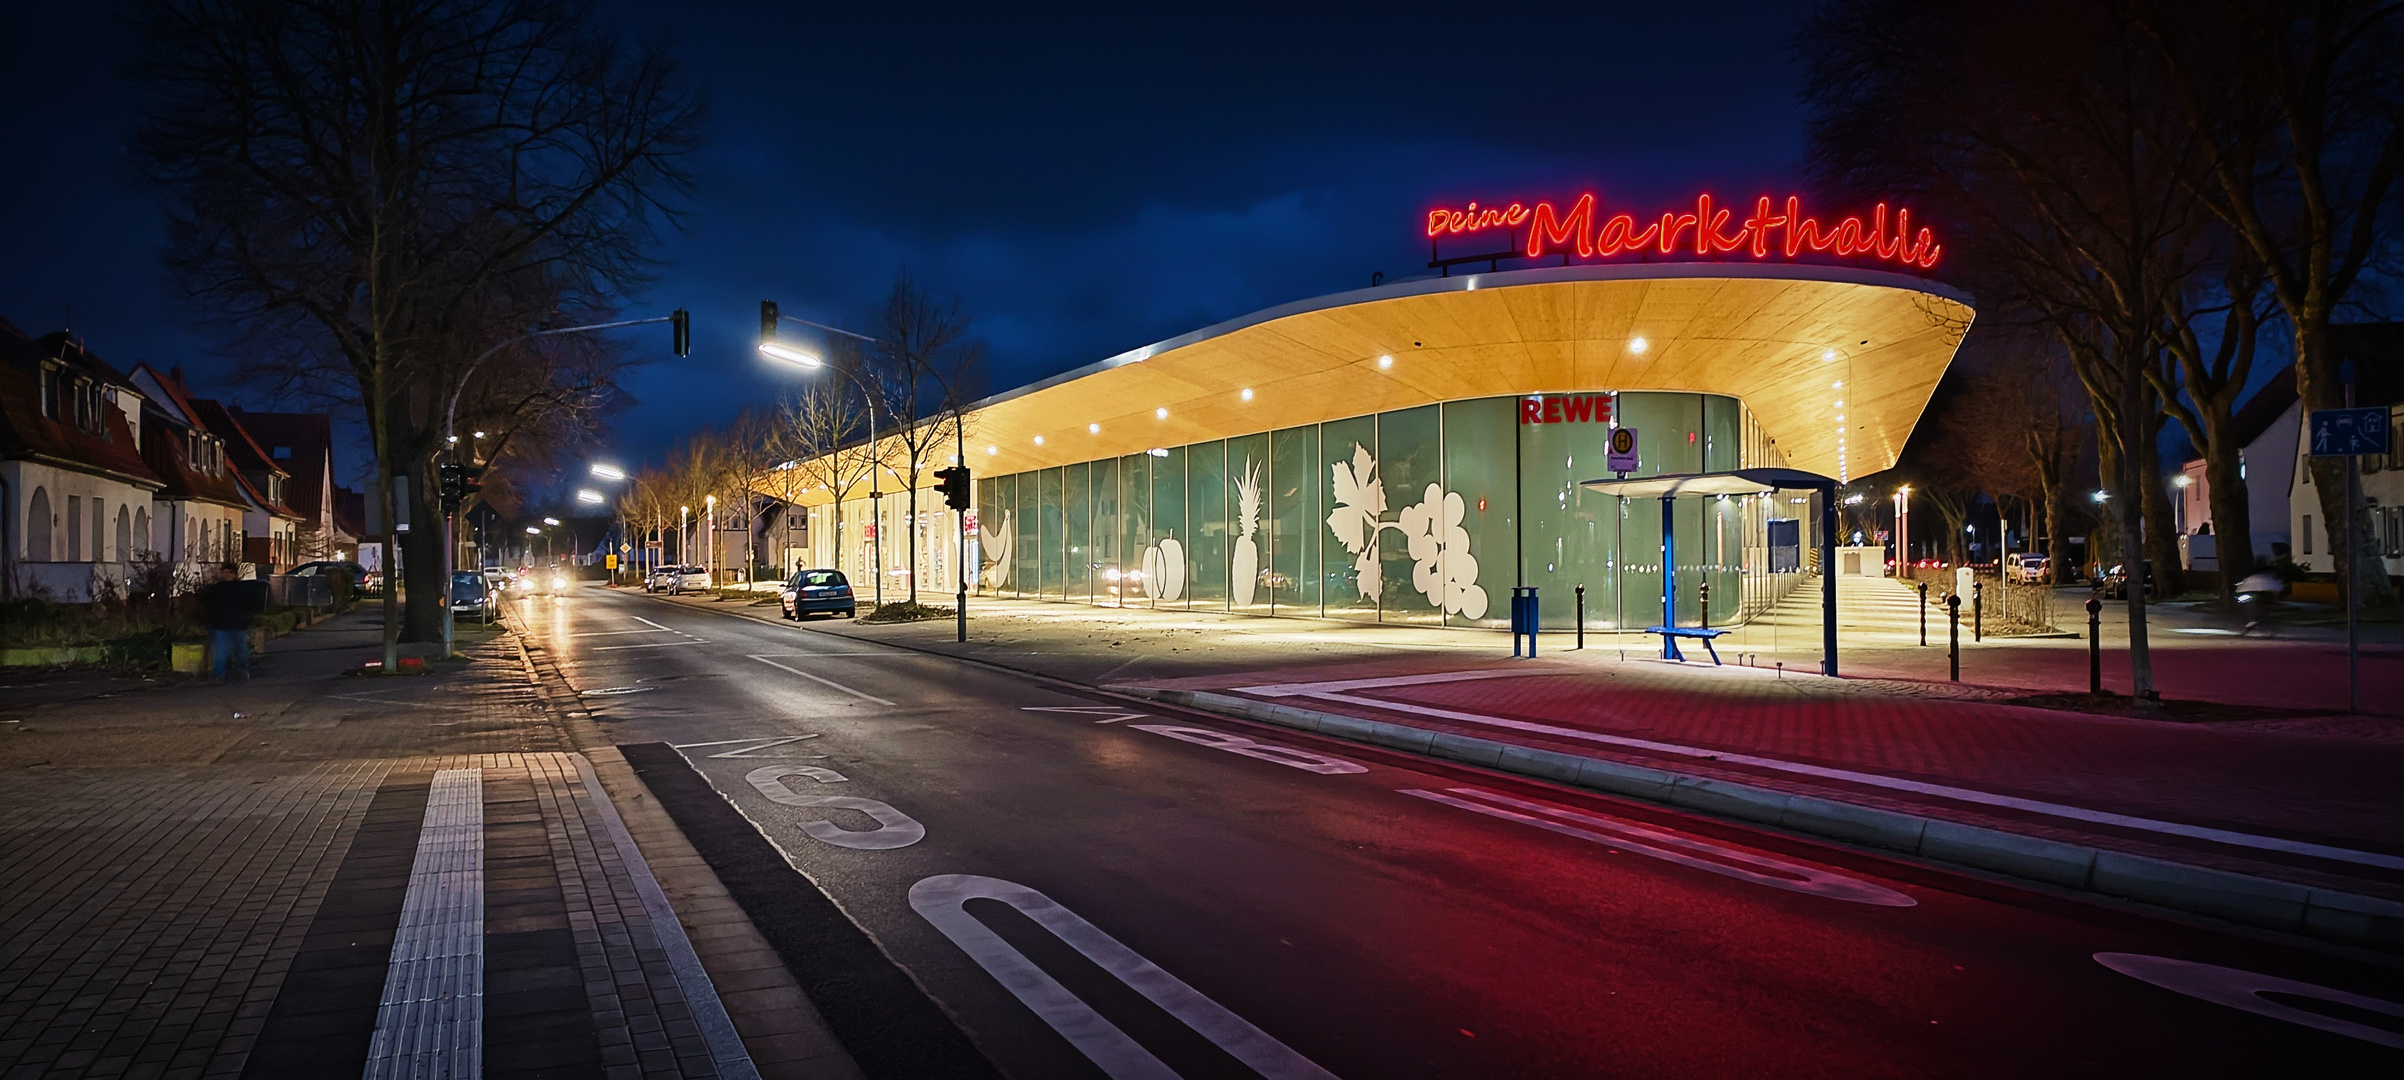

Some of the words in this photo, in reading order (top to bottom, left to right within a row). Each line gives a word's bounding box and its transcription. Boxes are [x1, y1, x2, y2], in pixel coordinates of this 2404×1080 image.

[1428, 202, 1530, 237] Deine
[1528, 193, 1941, 267] Markthalle
[1521, 395, 1613, 425] REWE
